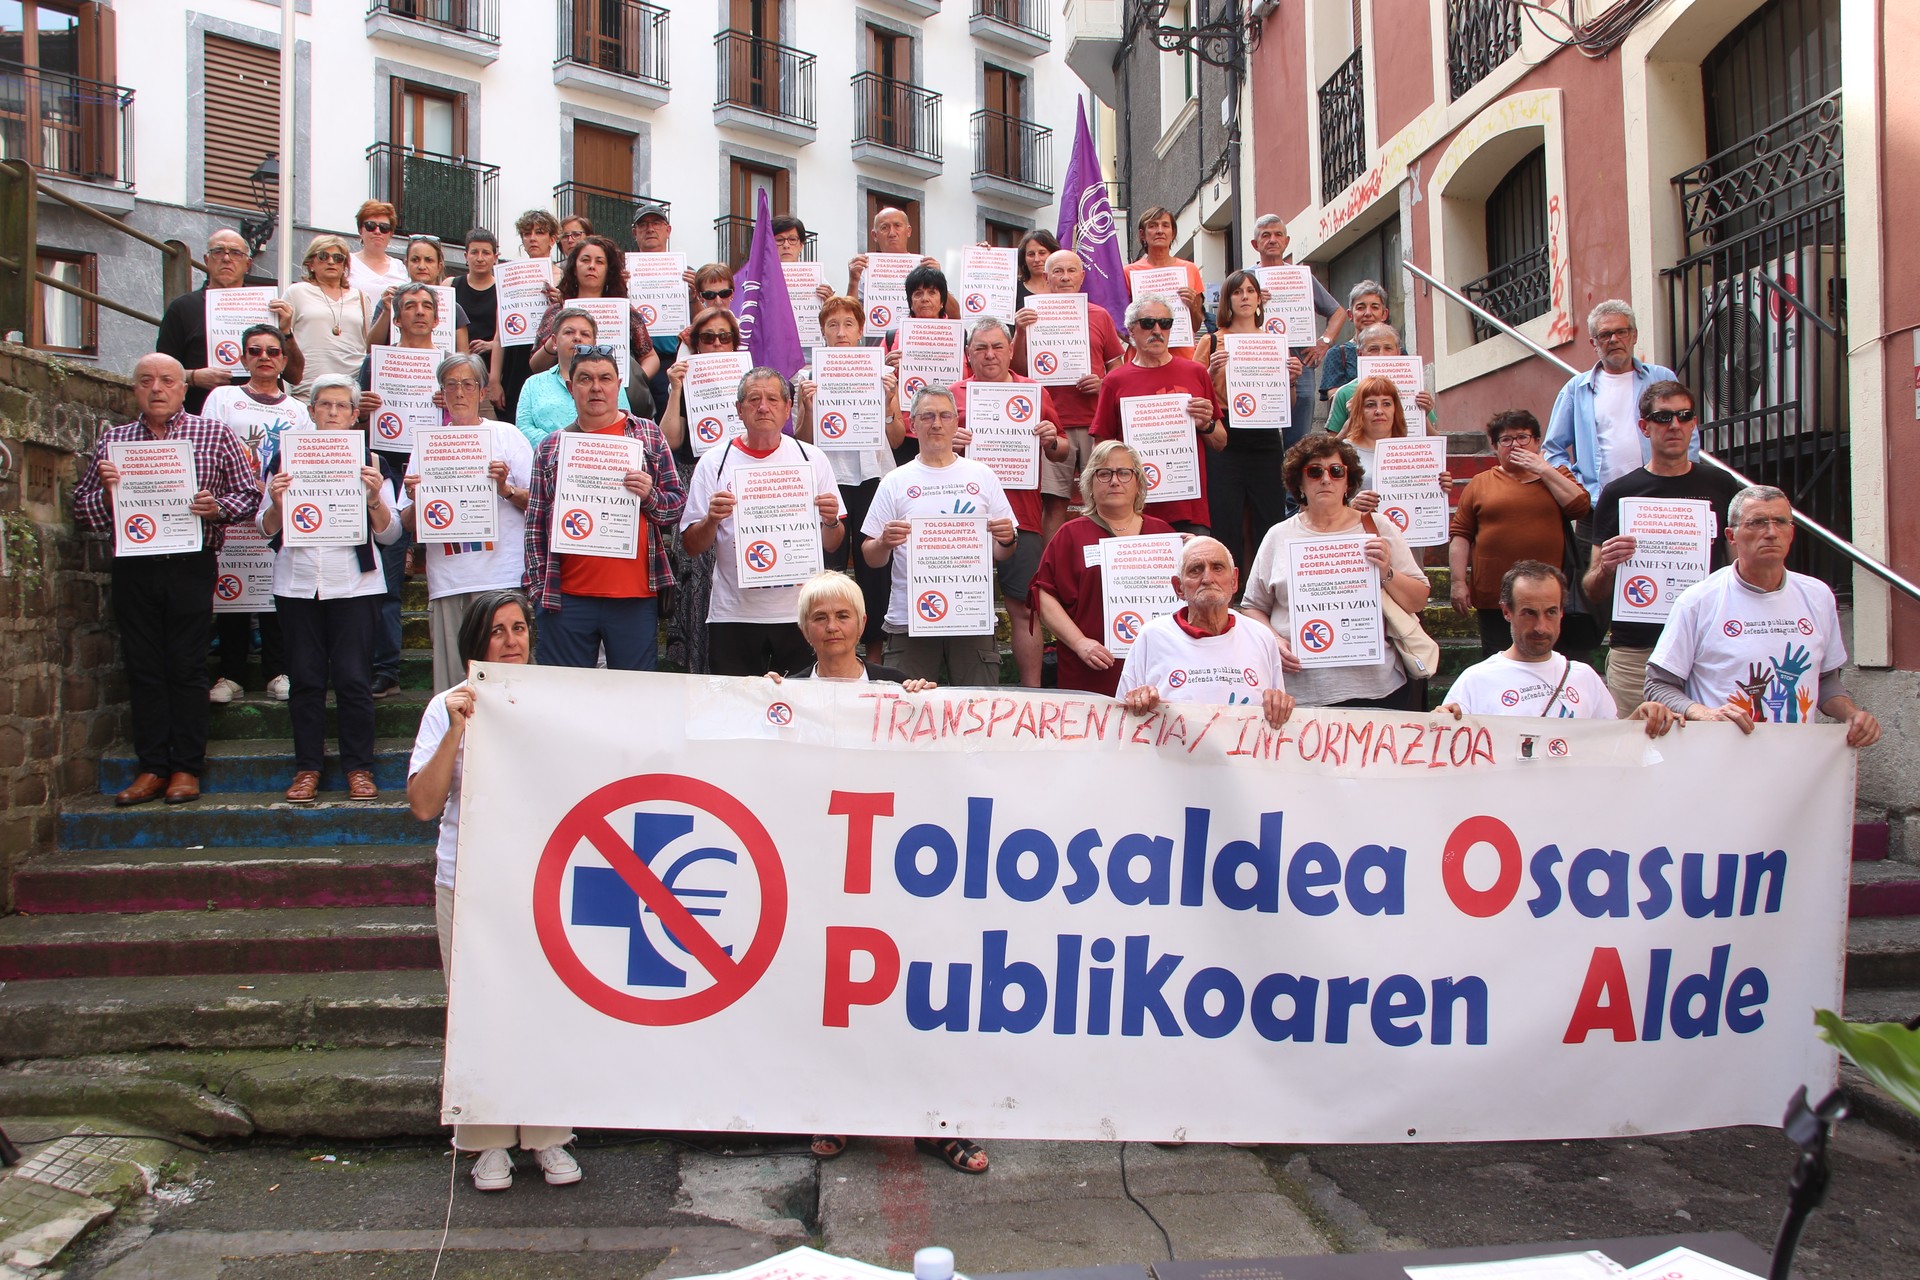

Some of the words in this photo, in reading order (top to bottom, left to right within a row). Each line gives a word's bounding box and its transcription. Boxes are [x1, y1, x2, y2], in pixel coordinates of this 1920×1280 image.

[577, 440, 628, 450] TOLOSALDEKO
[575, 447, 628, 458] OSASUNGINTZA
[1136, 446, 1193, 457] ANIFESTAZIOA
[567, 462, 606, 470] IRTENBIDEA
[421, 484, 492, 492] MANIFESTAZIOA
[561, 492, 636, 506] MANIFESTAZIOA
[1636, 512, 1694, 520] OSASUNGINTZA
[740, 522, 815, 534] MANIFESTAZIOA
[1304, 543, 1359, 551] TOLOSALDEKO
[1303, 551, 1361, 560] OSASUNGINTZA
[1623, 558, 1705, 571] MANIFESTAZIOA
[913, 574, 988, 583] MANIFESTAZIOA
[1295, 599, 1376, 612] MANIFESTAZIOA
[827, 790, 1408, 918] Tolosaldea
[1441, 815, 1788, 919] Osasun
[822, 925, 1489, 1046] Publikoaren
[1562, 944, 1769, 1045] Alde
